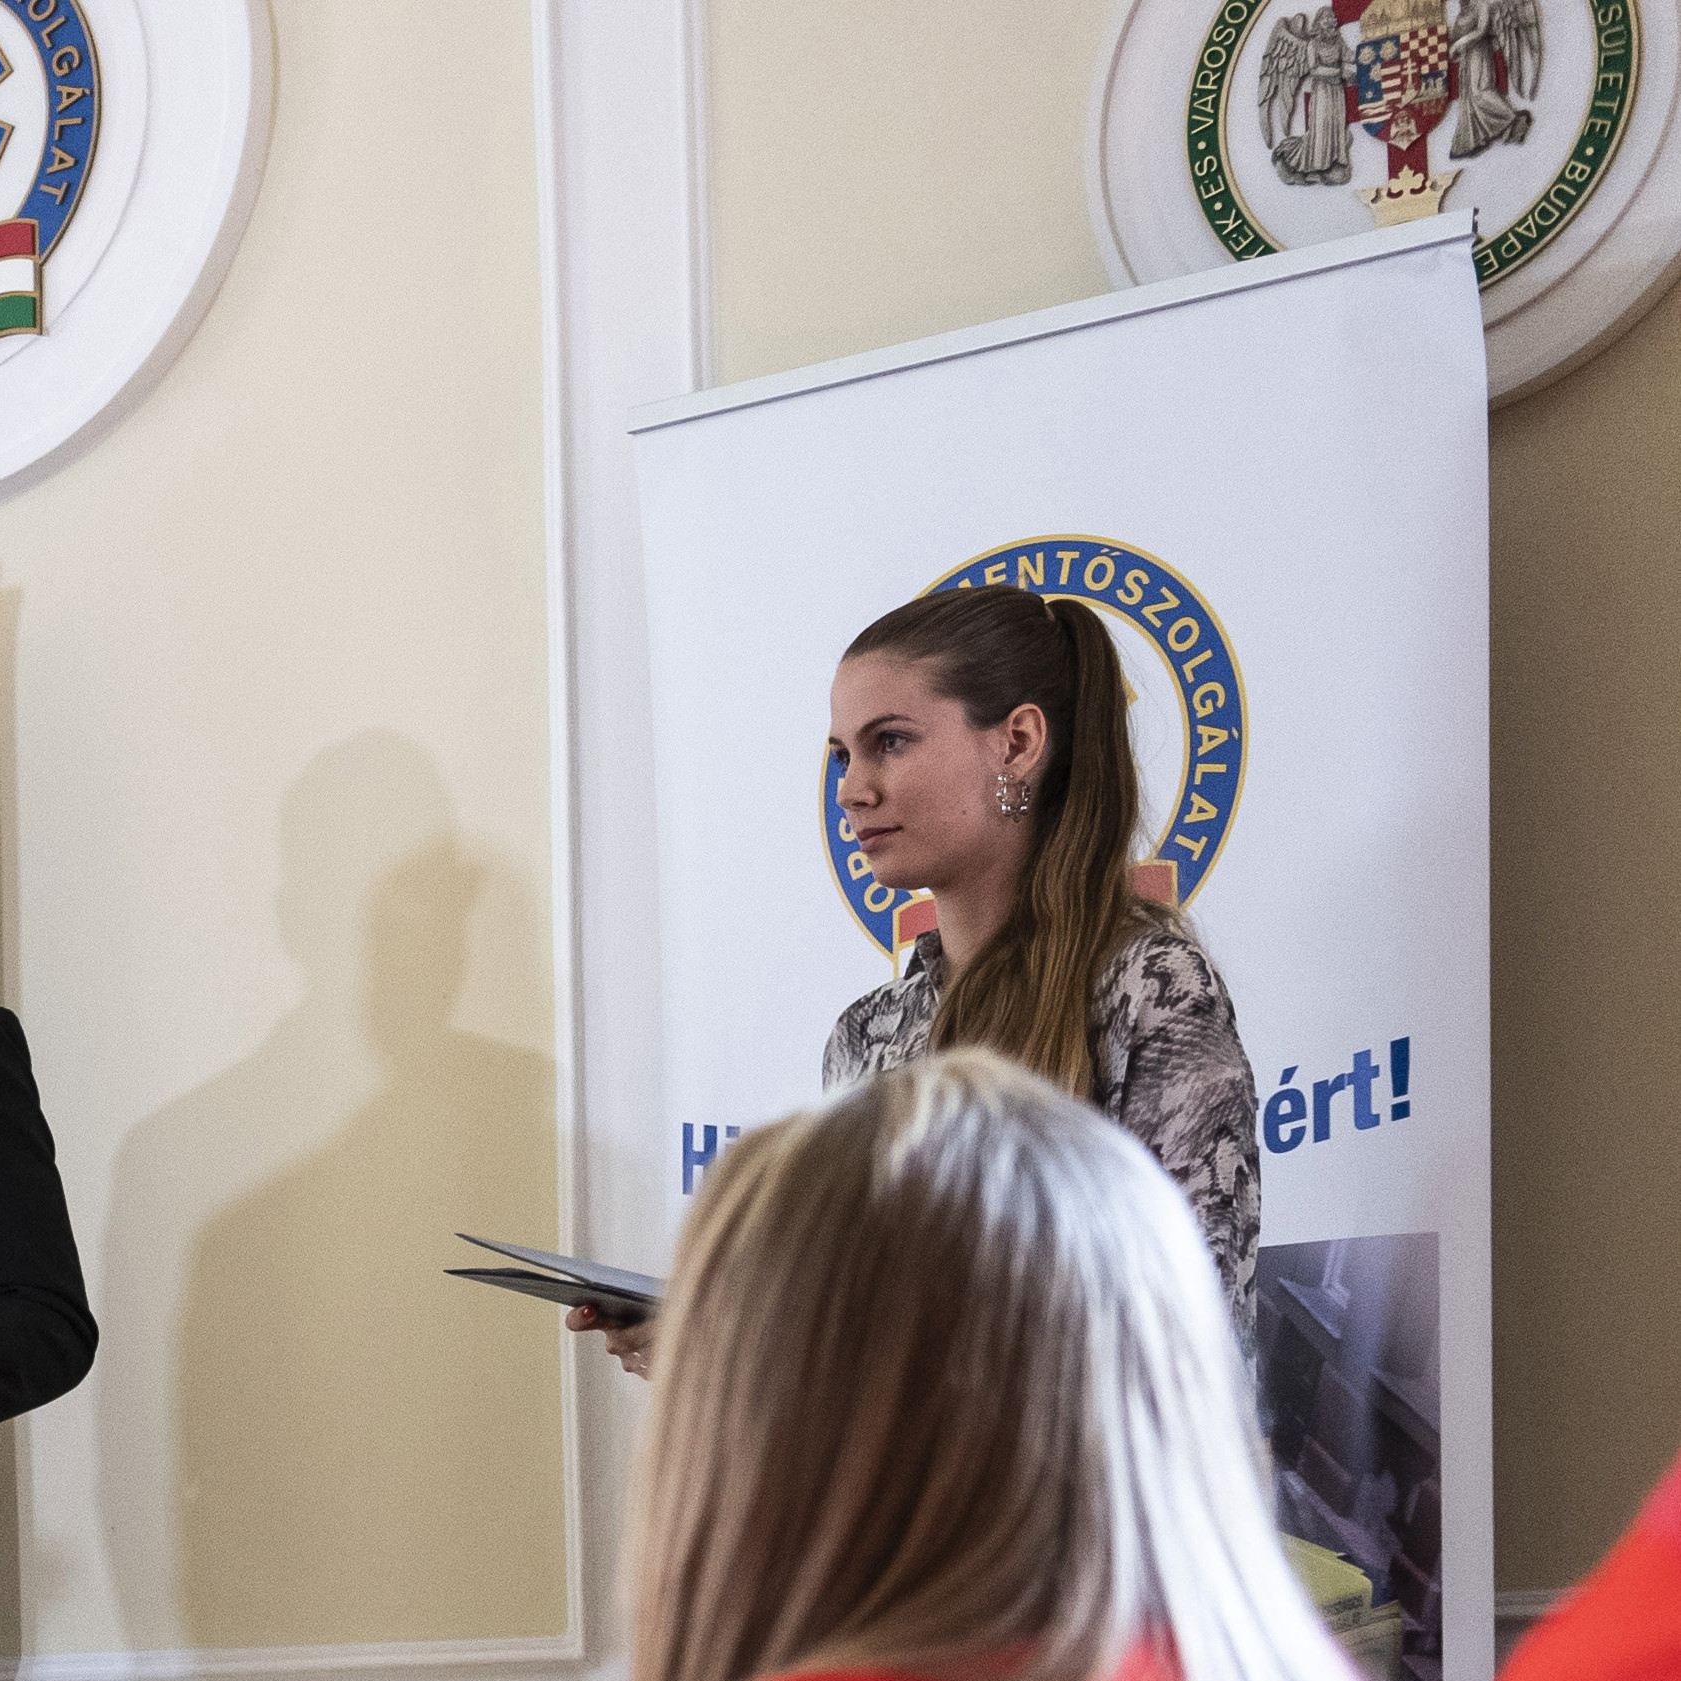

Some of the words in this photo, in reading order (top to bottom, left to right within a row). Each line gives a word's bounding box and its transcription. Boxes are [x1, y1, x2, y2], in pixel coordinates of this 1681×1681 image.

[24, 0, 93, 206] OLGÁLAT
[1190, 0, 1251, 135] VÁROSO
[1583, 0, 1629, 139] SÜLETE
[1194, 155, 1226, 200] ÉS
[1474, 159, 1591, 277] BUDAPE
[1258, 1035, 1411, 1155] ért!
